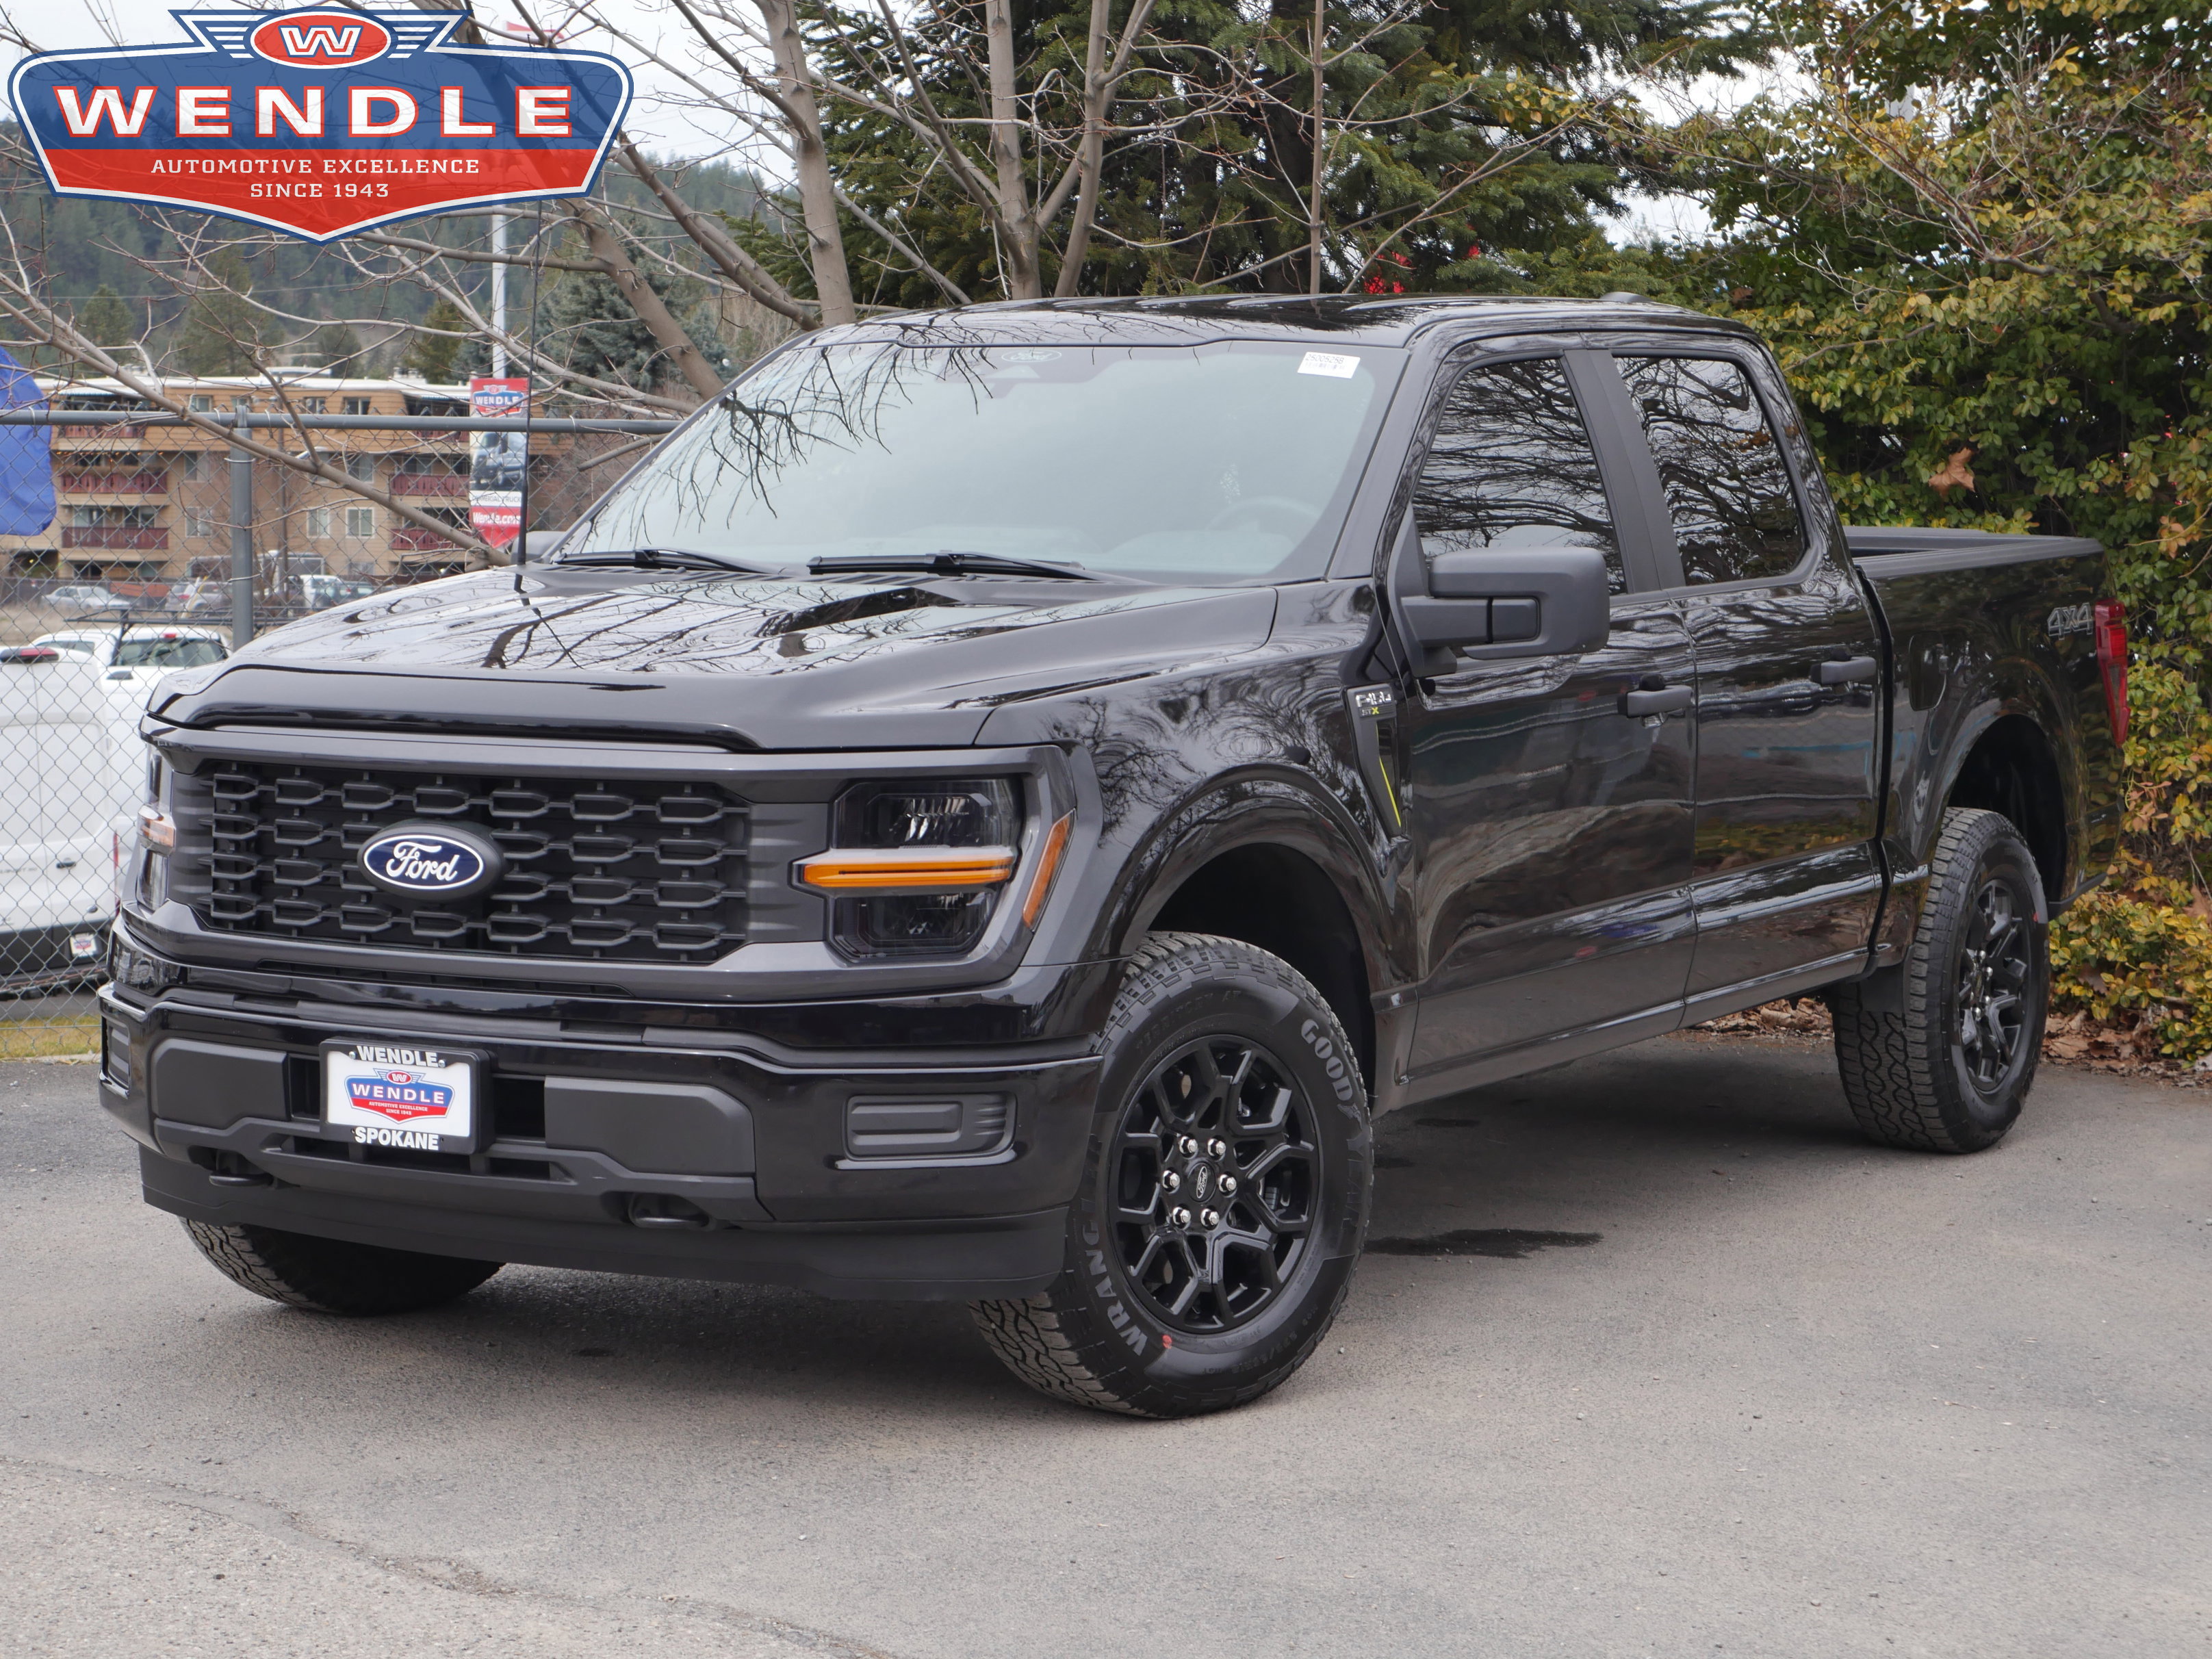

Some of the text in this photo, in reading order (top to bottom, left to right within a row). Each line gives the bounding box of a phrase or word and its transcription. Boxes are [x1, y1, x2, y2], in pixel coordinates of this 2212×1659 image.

[475, 396, 519, 406] WENDLE
[1362, 707, 1379, 715] STX
[386, 841, 460, 881] Ford
[357, 1046, 439, 1067] WENDLE
[352, 1083, 444, 1103] WENDLE
[368, 1101, 428, 1111] AUTOMOTIVE EXCELLENCE
[355, 1127, 439, 1150] SPOKANE
